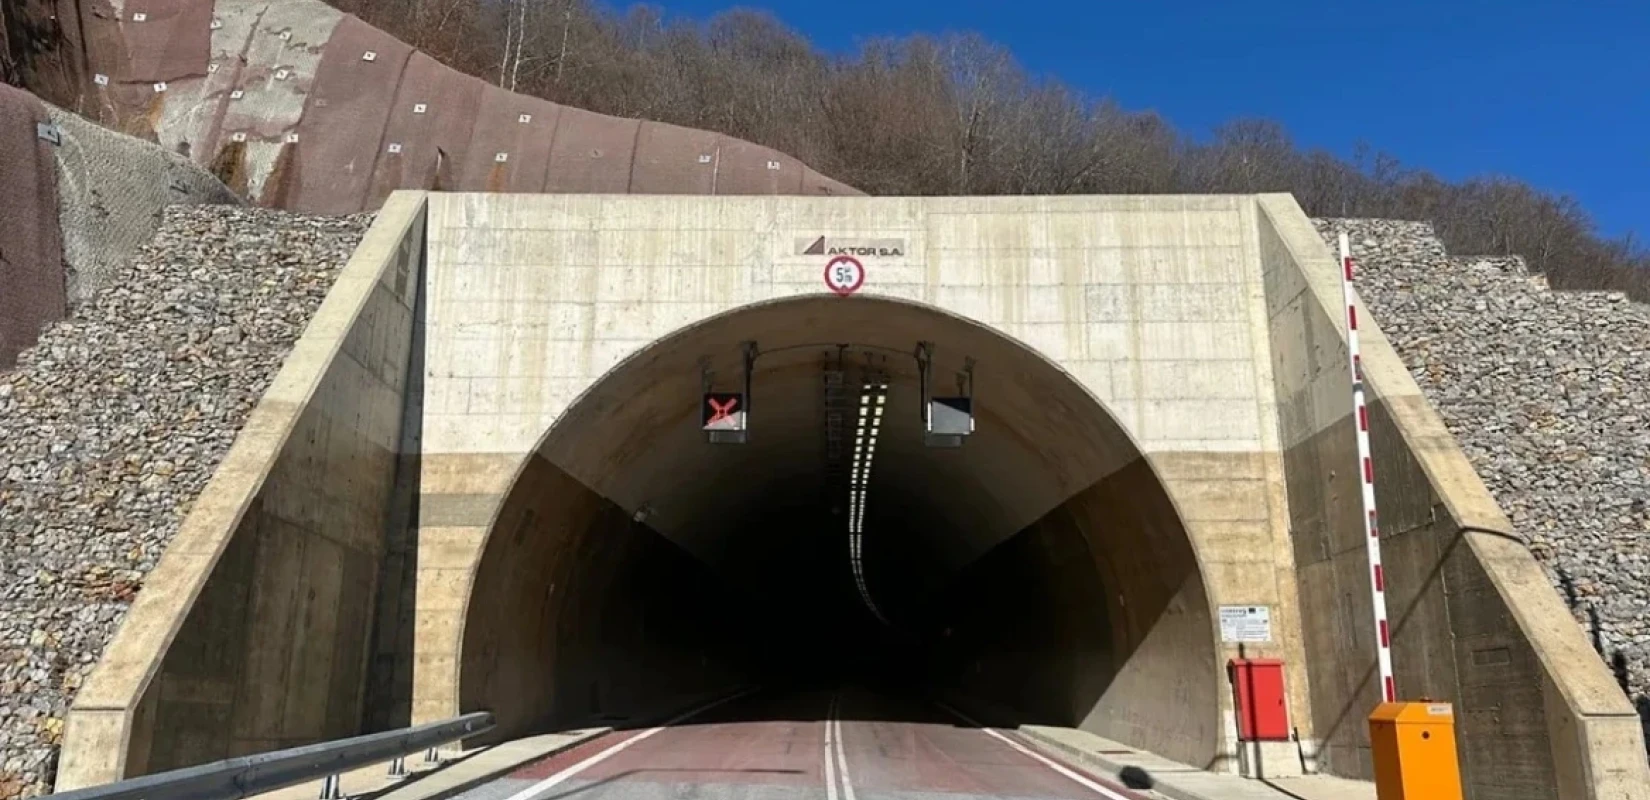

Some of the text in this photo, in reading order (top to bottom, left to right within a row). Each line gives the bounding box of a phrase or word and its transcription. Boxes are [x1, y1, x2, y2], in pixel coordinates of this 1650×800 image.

[828, 247, 904, 255] AKTOR S.A.
[836, 267, 844, 283] 5
